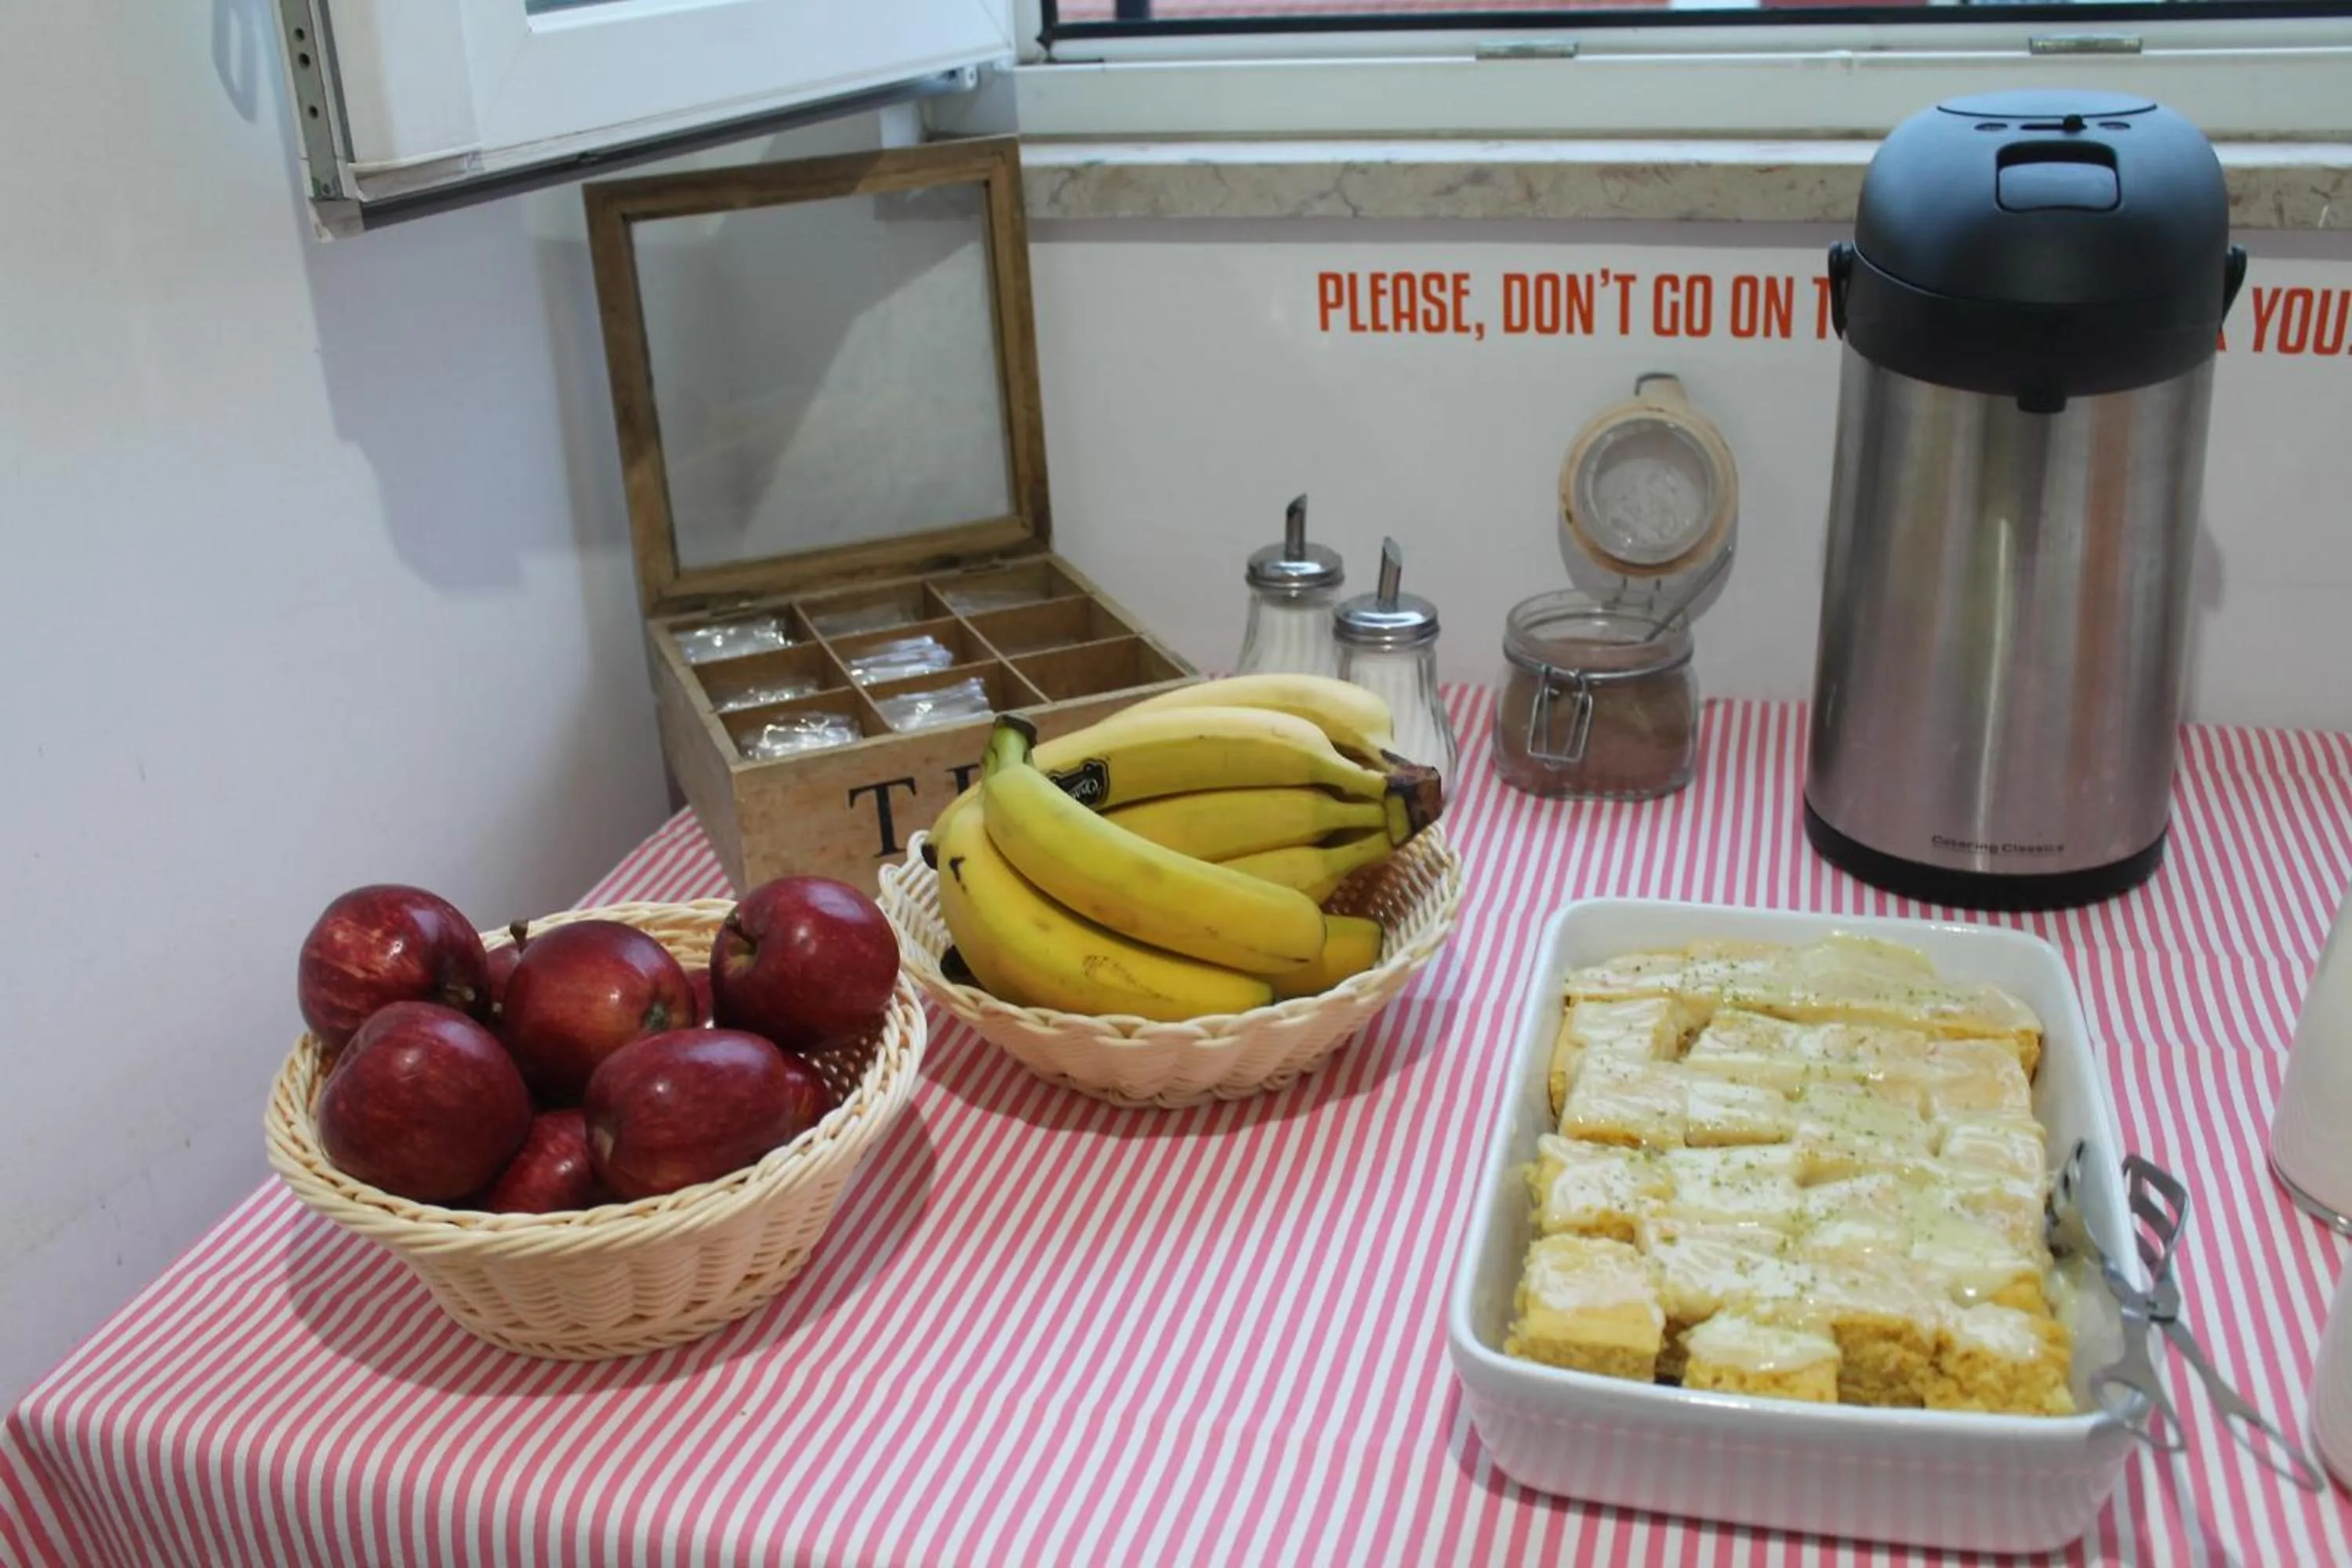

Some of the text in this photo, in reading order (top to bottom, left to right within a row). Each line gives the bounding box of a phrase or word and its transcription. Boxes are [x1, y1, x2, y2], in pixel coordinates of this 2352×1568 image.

[1319, 270, 1485, 340] PLEASE,
[1503, 268, 1636, 336] DON'T
[1653, 274, 1713, 339] GO
[1730, 274, 1794, 339] ON
